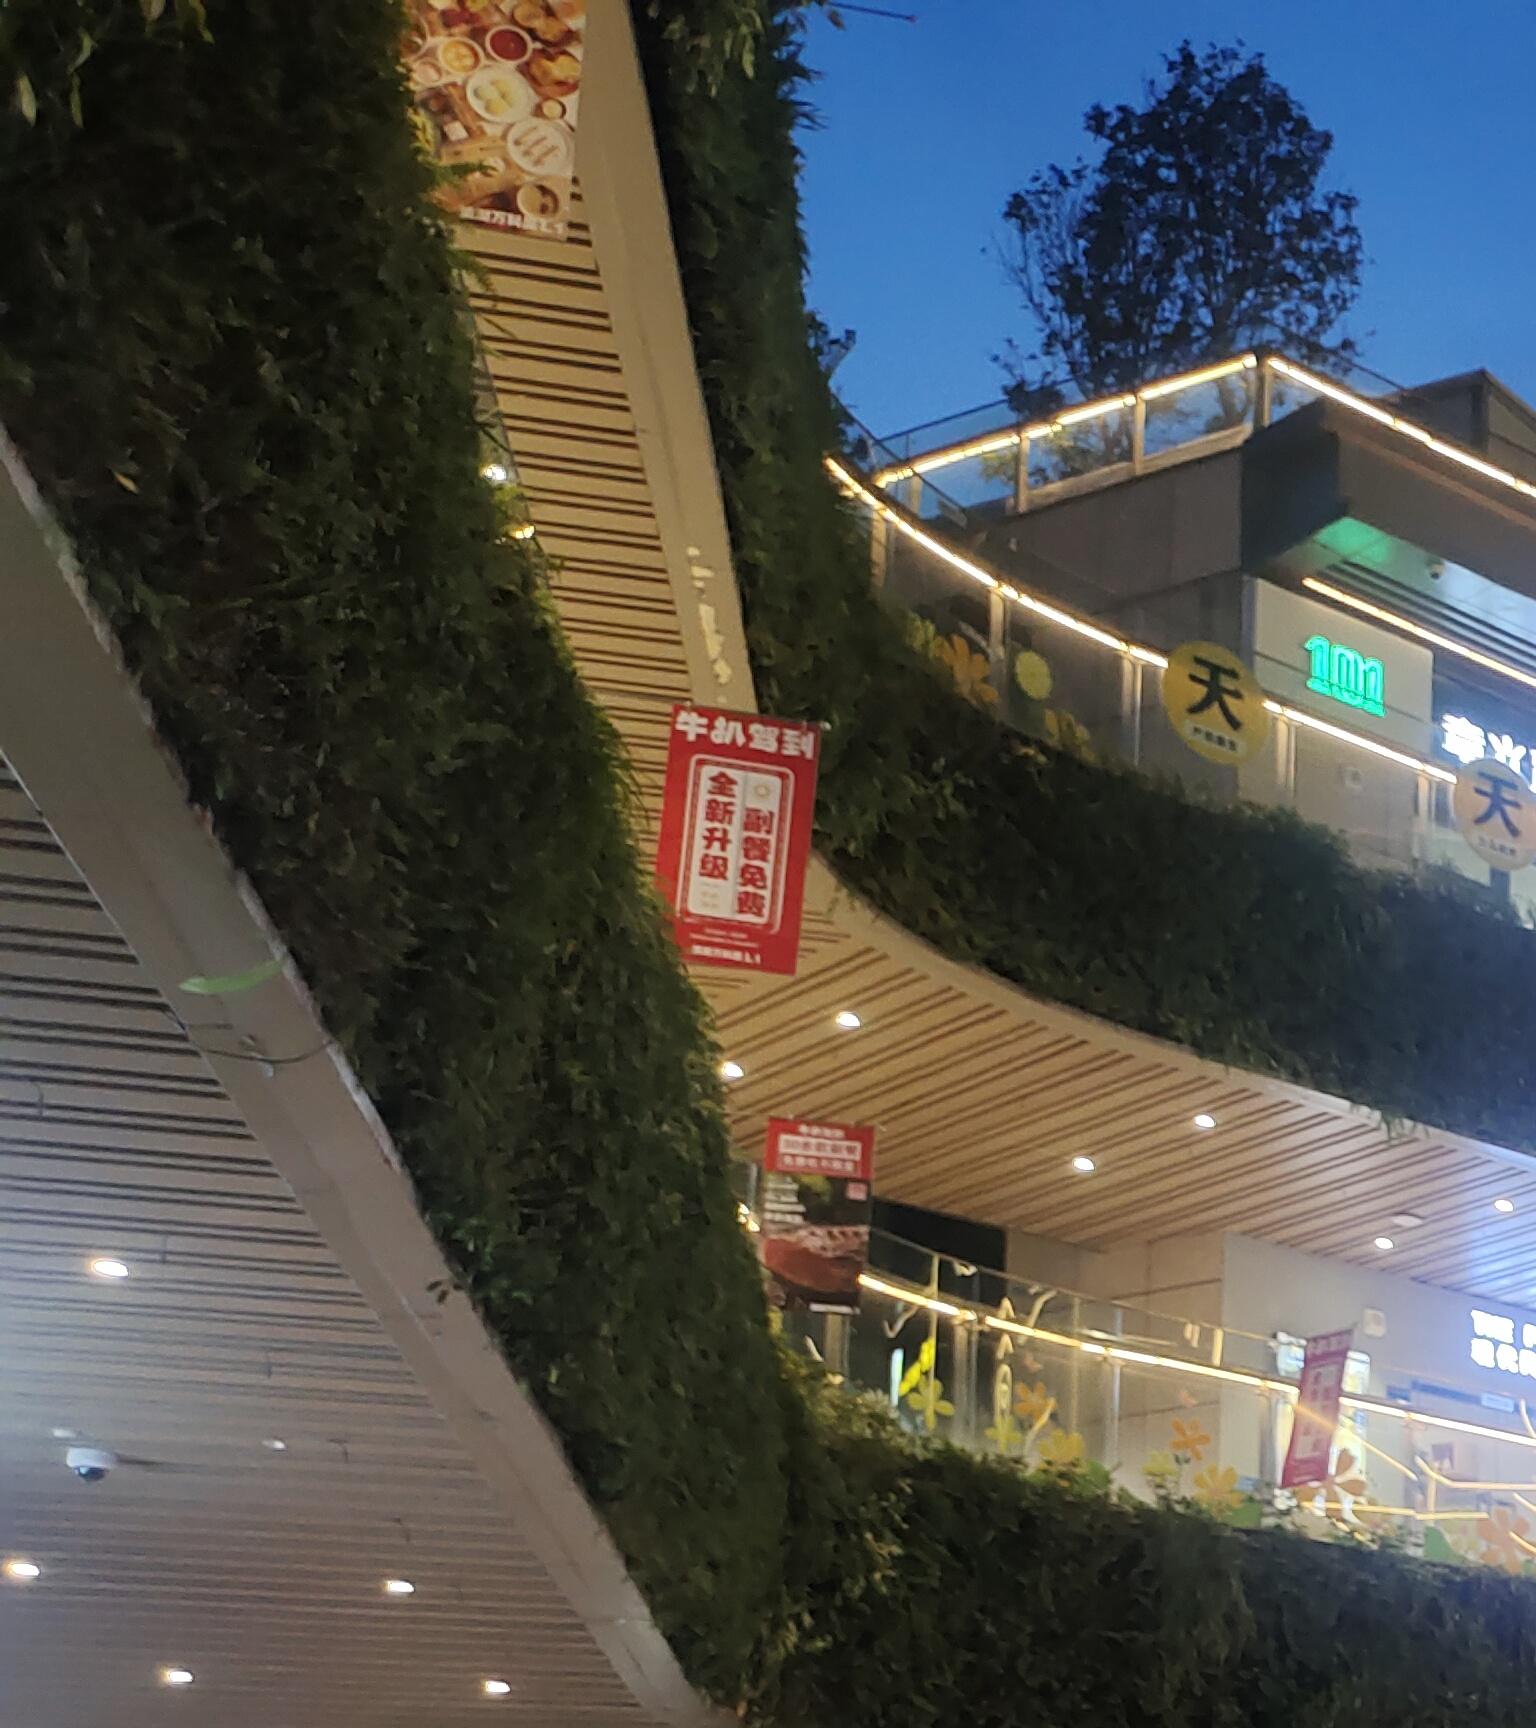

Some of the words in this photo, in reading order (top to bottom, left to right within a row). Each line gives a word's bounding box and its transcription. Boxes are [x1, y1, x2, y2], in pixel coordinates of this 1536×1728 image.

[1186, 656, 1244, 731] 天
[698, 770, 738, 881] 全新升级
[1474, 770, 1522, 838] 天
[736, 807, 776, 918] 副餐免费
